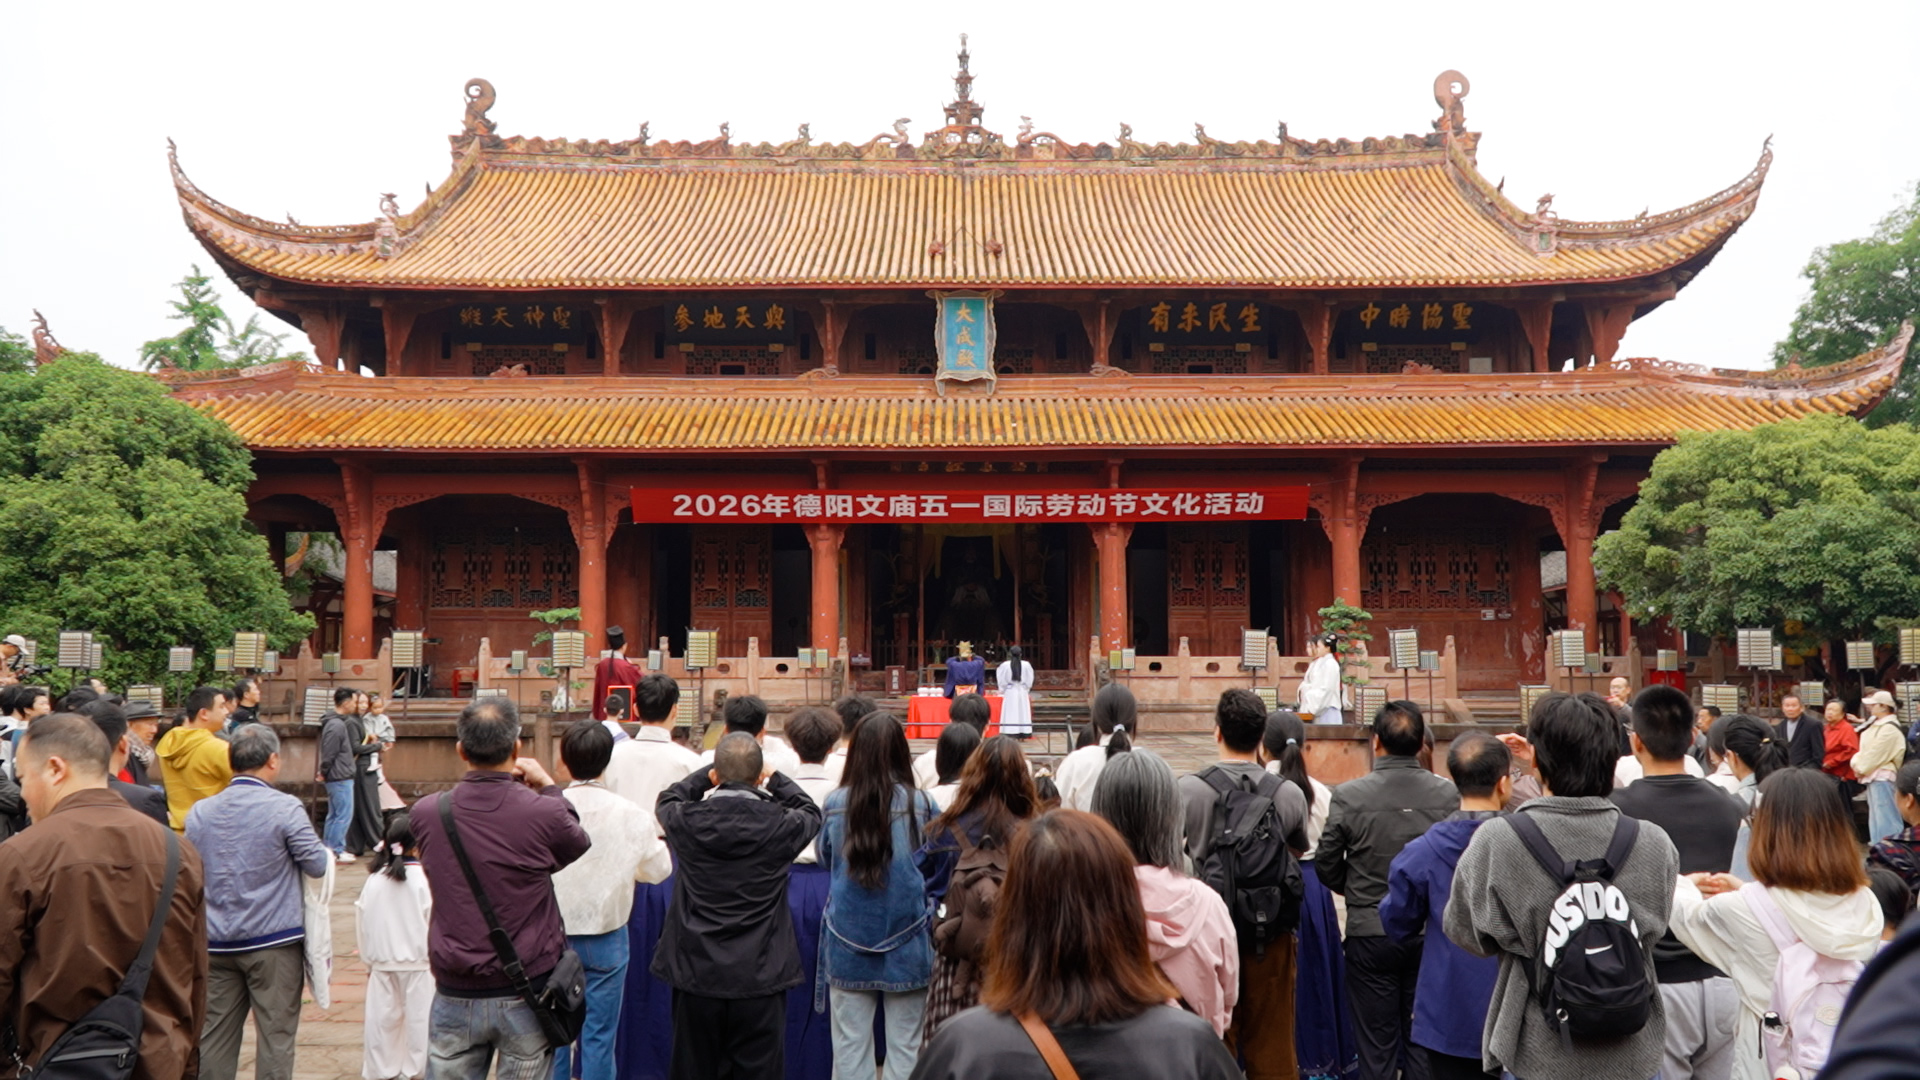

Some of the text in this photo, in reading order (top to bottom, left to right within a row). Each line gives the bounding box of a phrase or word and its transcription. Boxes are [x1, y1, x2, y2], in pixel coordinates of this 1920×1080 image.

[955, 302, 977, 369] 大成殿
[672, 492, 1265, 518] 2026年德阳文庙五一国际劳动节文化活动
[1581, 881, 1630, 922] DO
